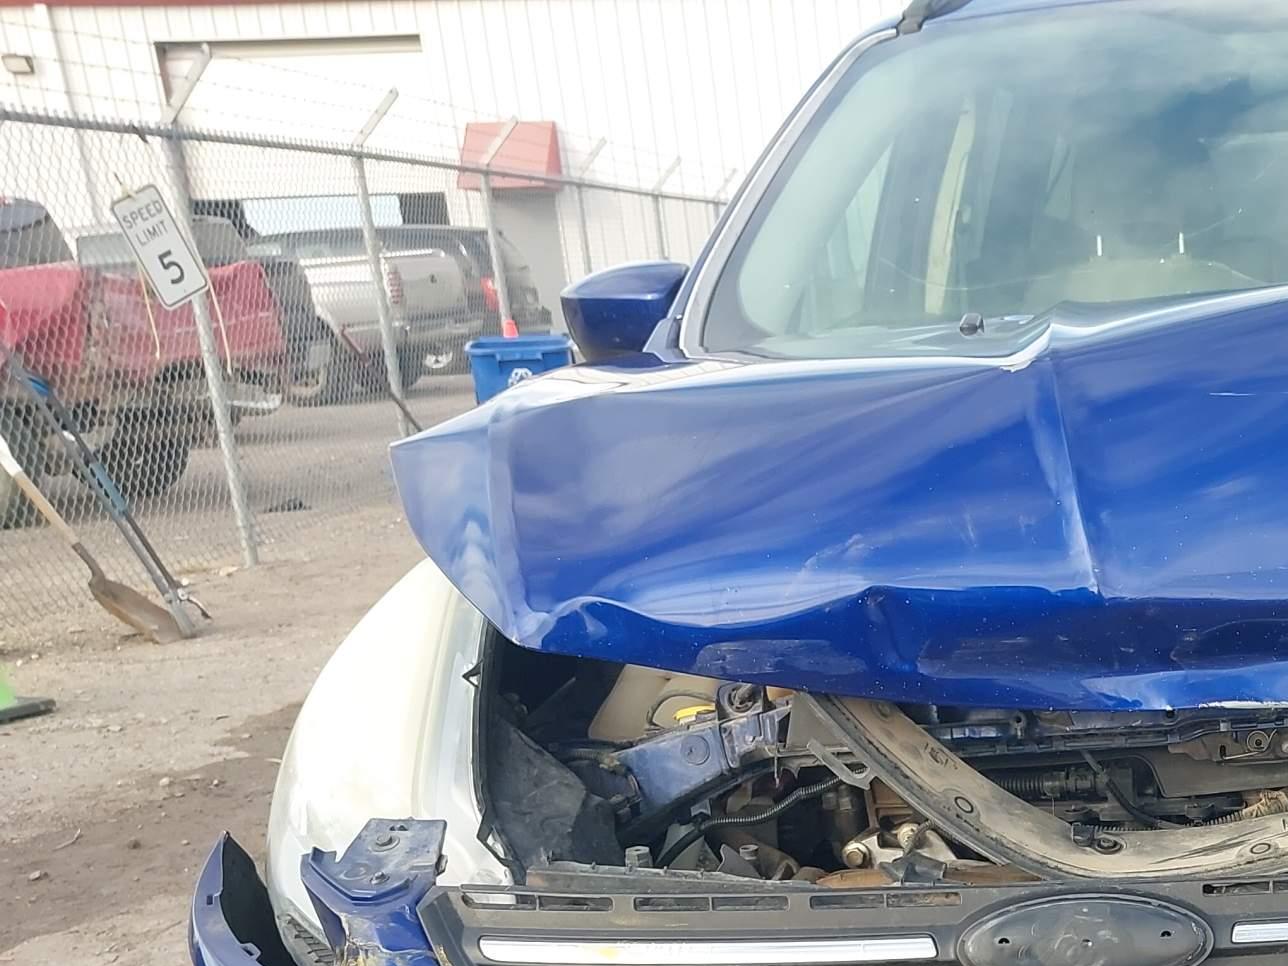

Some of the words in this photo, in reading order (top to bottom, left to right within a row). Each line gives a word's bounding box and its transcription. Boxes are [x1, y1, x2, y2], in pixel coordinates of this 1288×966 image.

[121, 200, 163, 230] SPEED
[135, 220, 169, 247] LIMIT
[157, 249, 185, 285] 5
